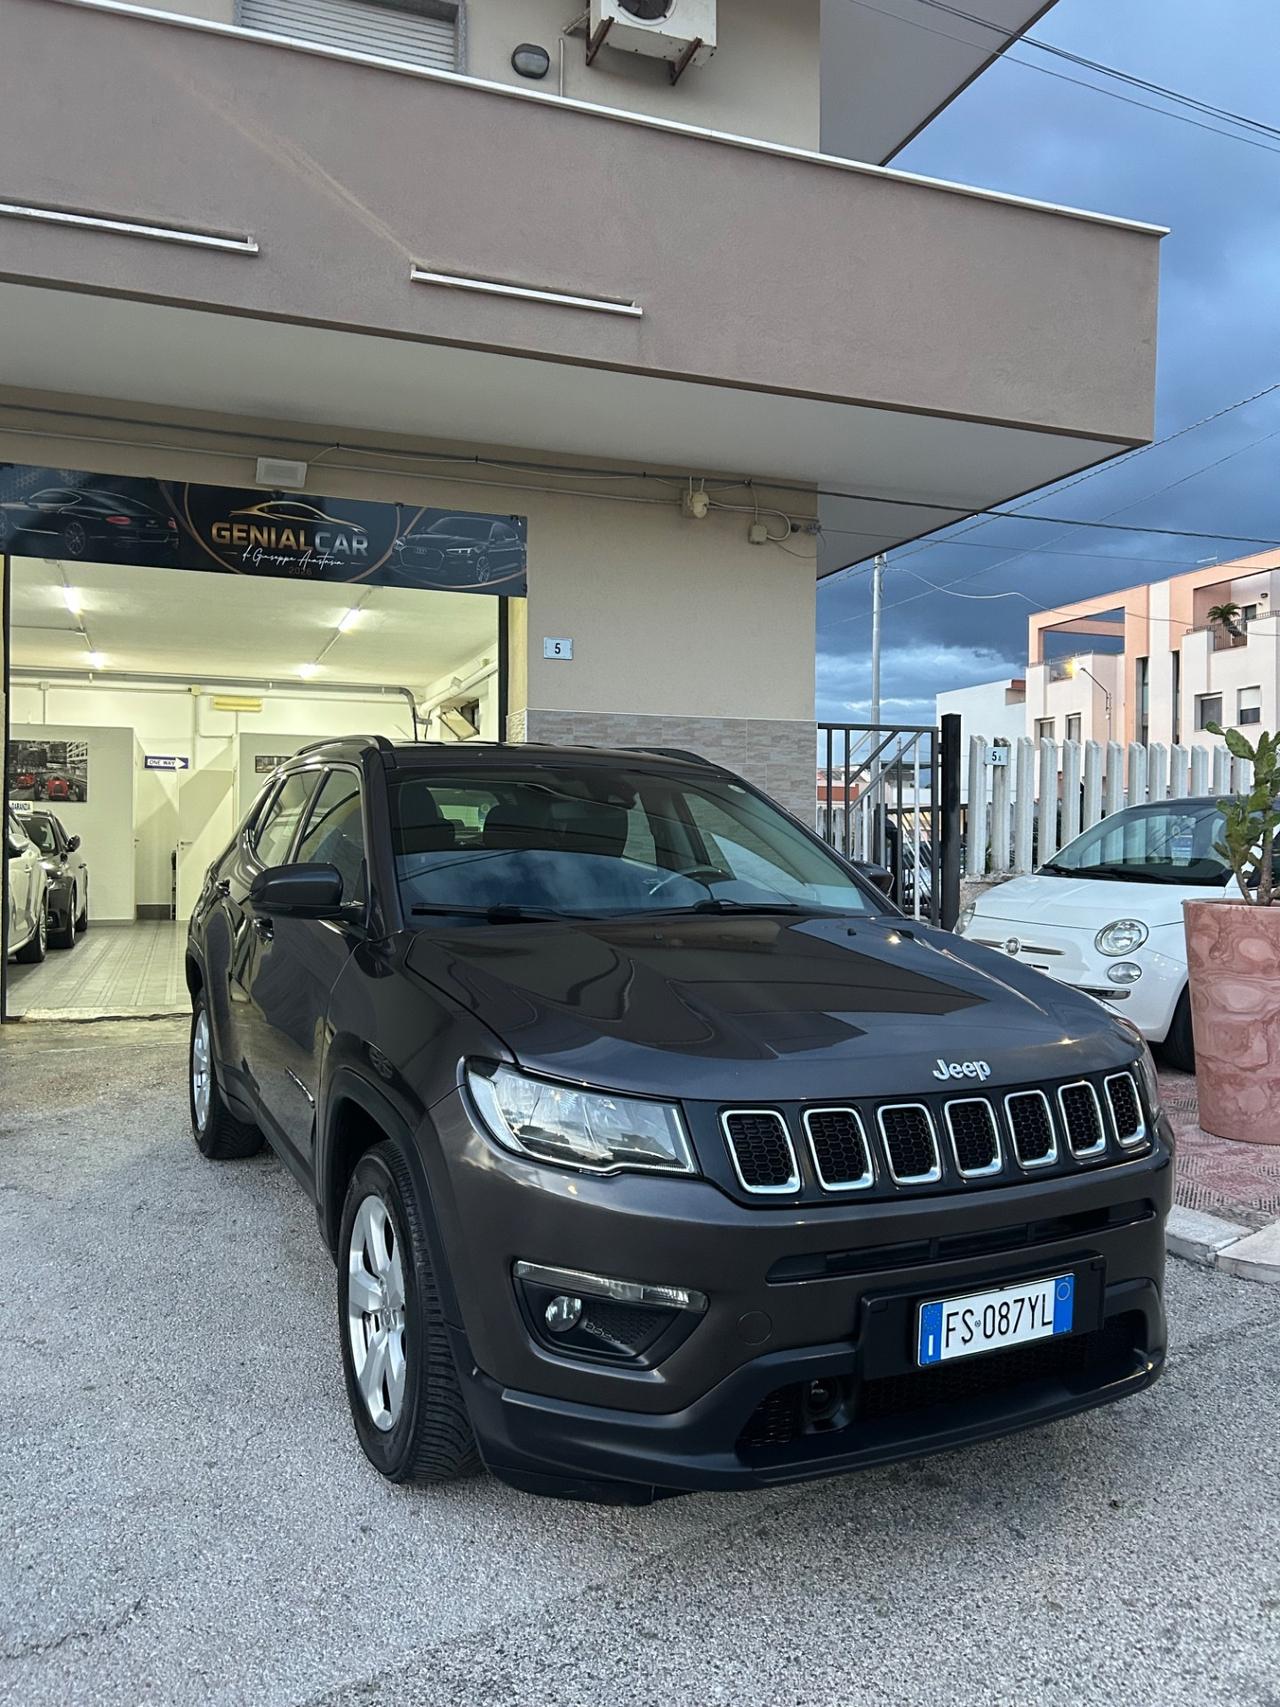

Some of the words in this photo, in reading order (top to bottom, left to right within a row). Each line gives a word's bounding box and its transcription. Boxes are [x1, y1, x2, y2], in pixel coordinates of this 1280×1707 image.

[252, 547, 297, 567] Giuseppe
[554, 642, 561, 655] 5
[932, 1058, 991, 1082] Jeep
